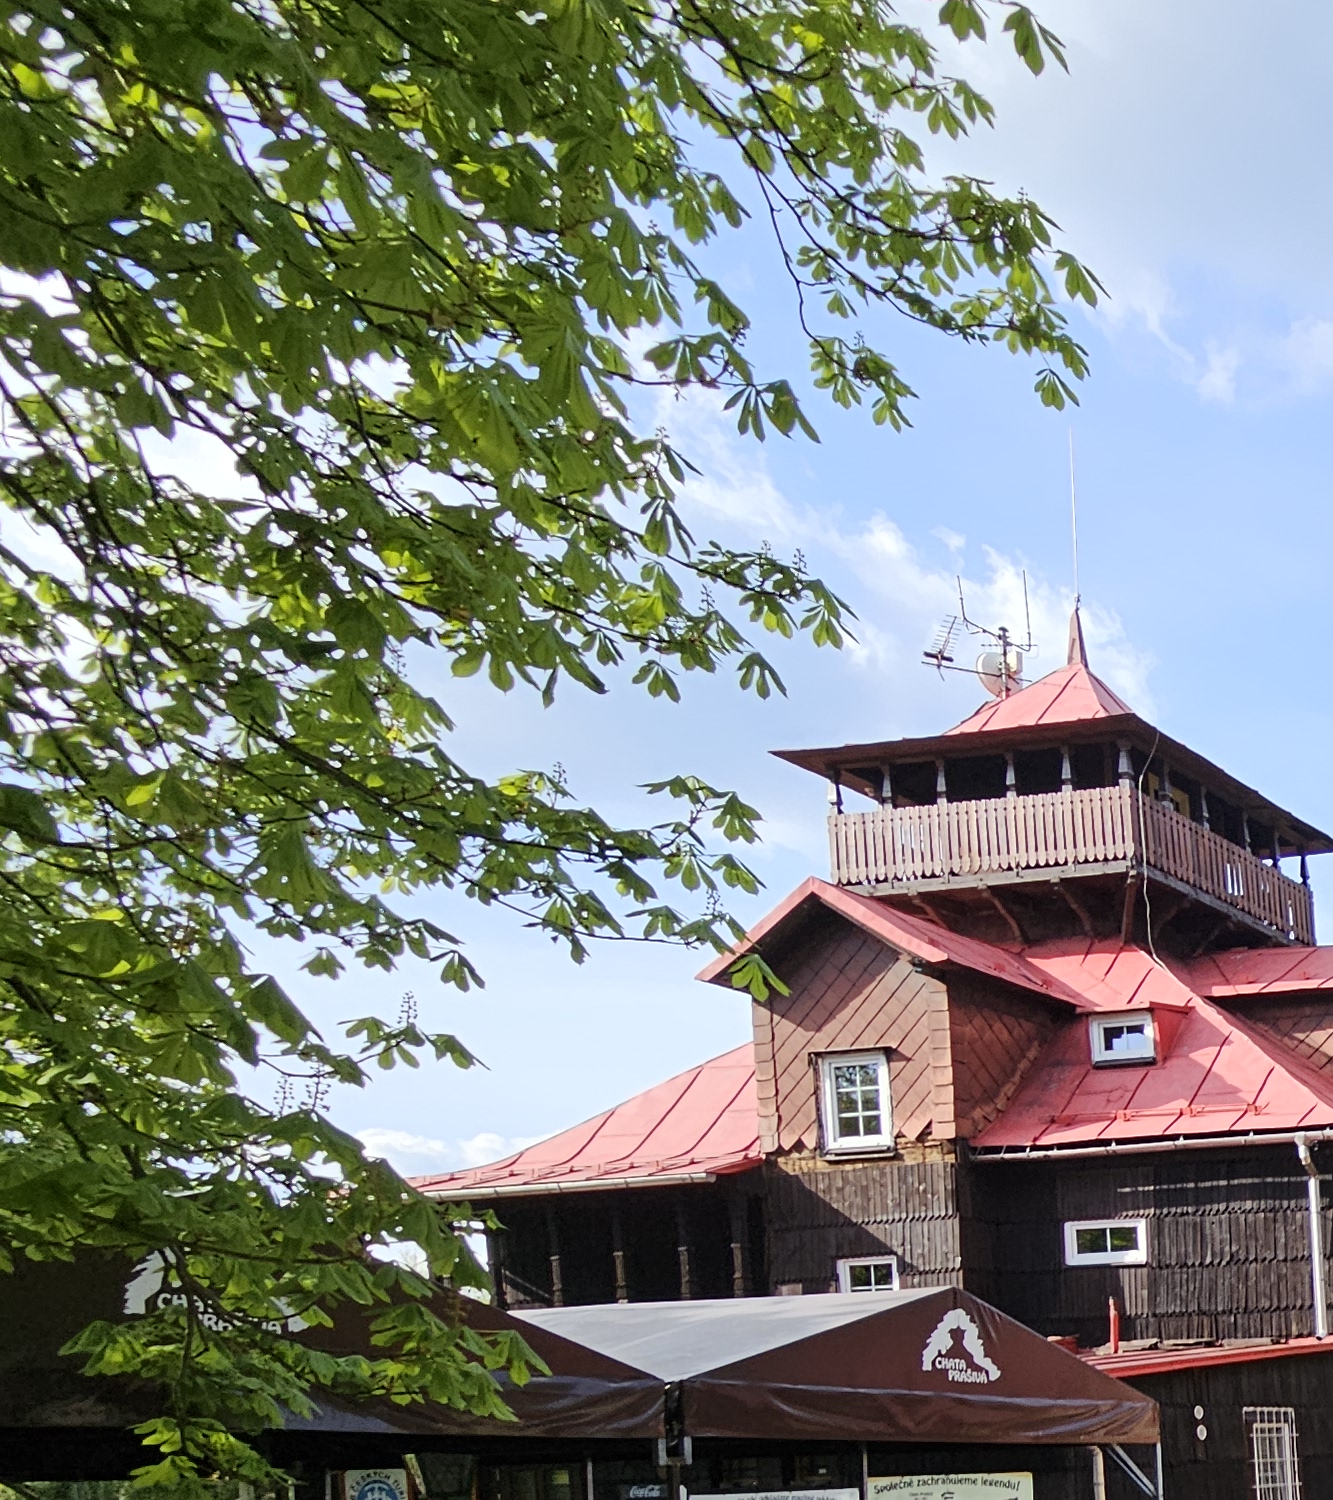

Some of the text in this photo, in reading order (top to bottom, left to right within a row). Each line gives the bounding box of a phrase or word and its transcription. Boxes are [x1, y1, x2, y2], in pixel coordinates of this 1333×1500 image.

[935, 1357, 966, 1369] CHATA
[948, 1368, 988, 1384] PRAŠIVÁ
[873, 1480, 914, 1495] Společně
[917, 1476, 978, 1487] zachraňujeme
